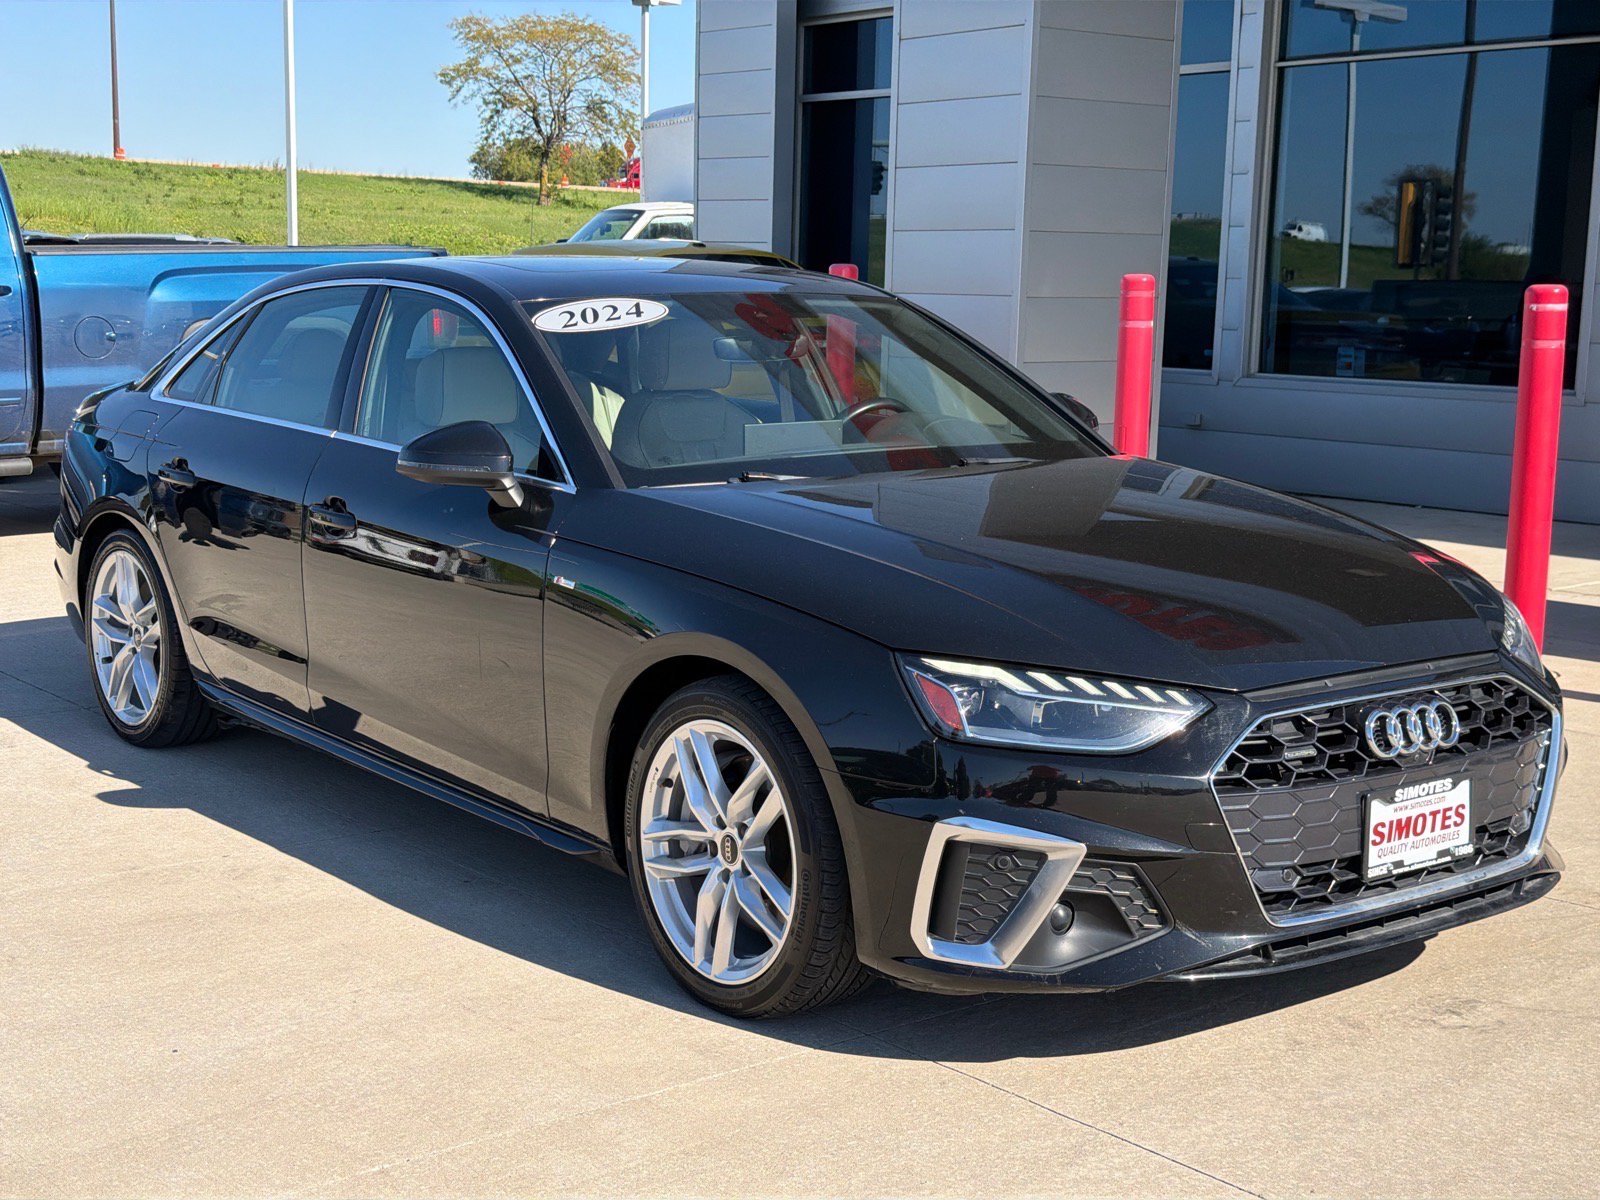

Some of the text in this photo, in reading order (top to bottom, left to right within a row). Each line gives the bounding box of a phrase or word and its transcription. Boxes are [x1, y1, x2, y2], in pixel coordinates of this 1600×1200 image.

[558, 301, 645, 329] 2024
[1394, 777, 1453, 802] SIMOTES
[1393, 795, 1446, 813] www.simotes.com
[1371, 803, 1466, 847] SIMOTES
[1377, 829, 1461, 859] QUALITY AUTOMOBILES
